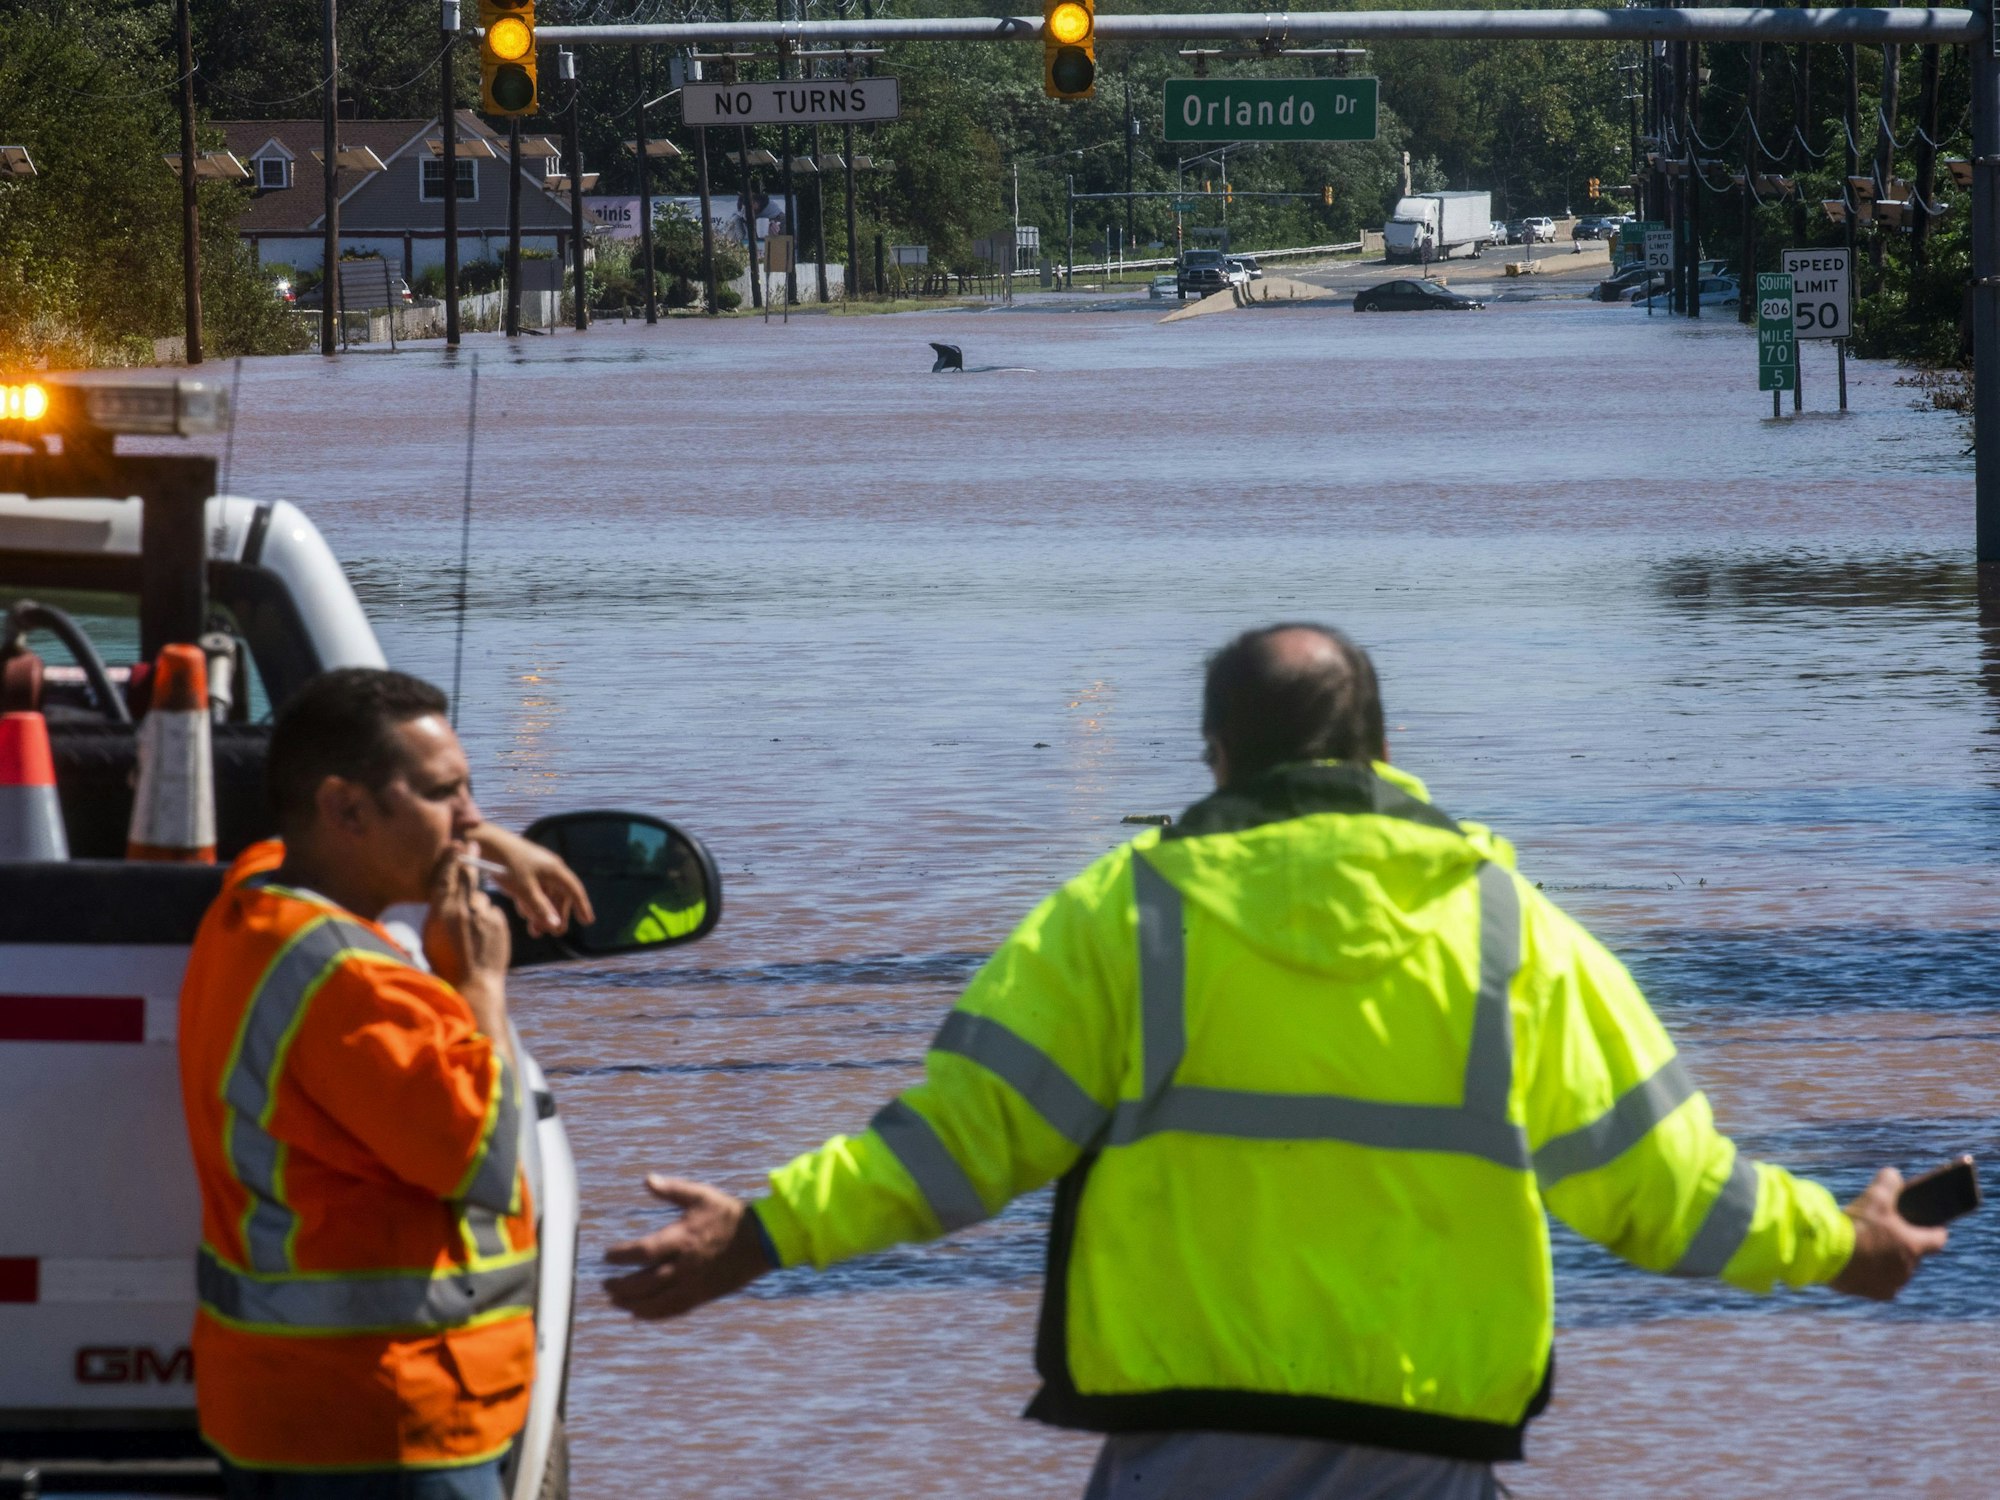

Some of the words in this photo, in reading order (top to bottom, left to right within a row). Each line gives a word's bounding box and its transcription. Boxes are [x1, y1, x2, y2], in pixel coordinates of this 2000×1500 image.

[715, 92, 752, 115] NO
[772, 88, 866, 114] TURNS
[1183, 94, 1316, 127] Orlando
[1335, 94, 1358, 115] Dr
[1647, 233, 1672, 241] SPEED
[1649, 253, 1669, 266] 50
[1788, 258, 1844, 272] SPEED
[1759, 275, 1791, 291] SOUTH
[1794, 279, 1838, 293] LIMIT
[1763, 302, 1788, 316] 206
[1796, 302, 1839, 330] 50
[1761, 329, 1792, 343] MILE
[1765, 345, 1787, 363] 70
[1770, 369, 1784, 388] .5
